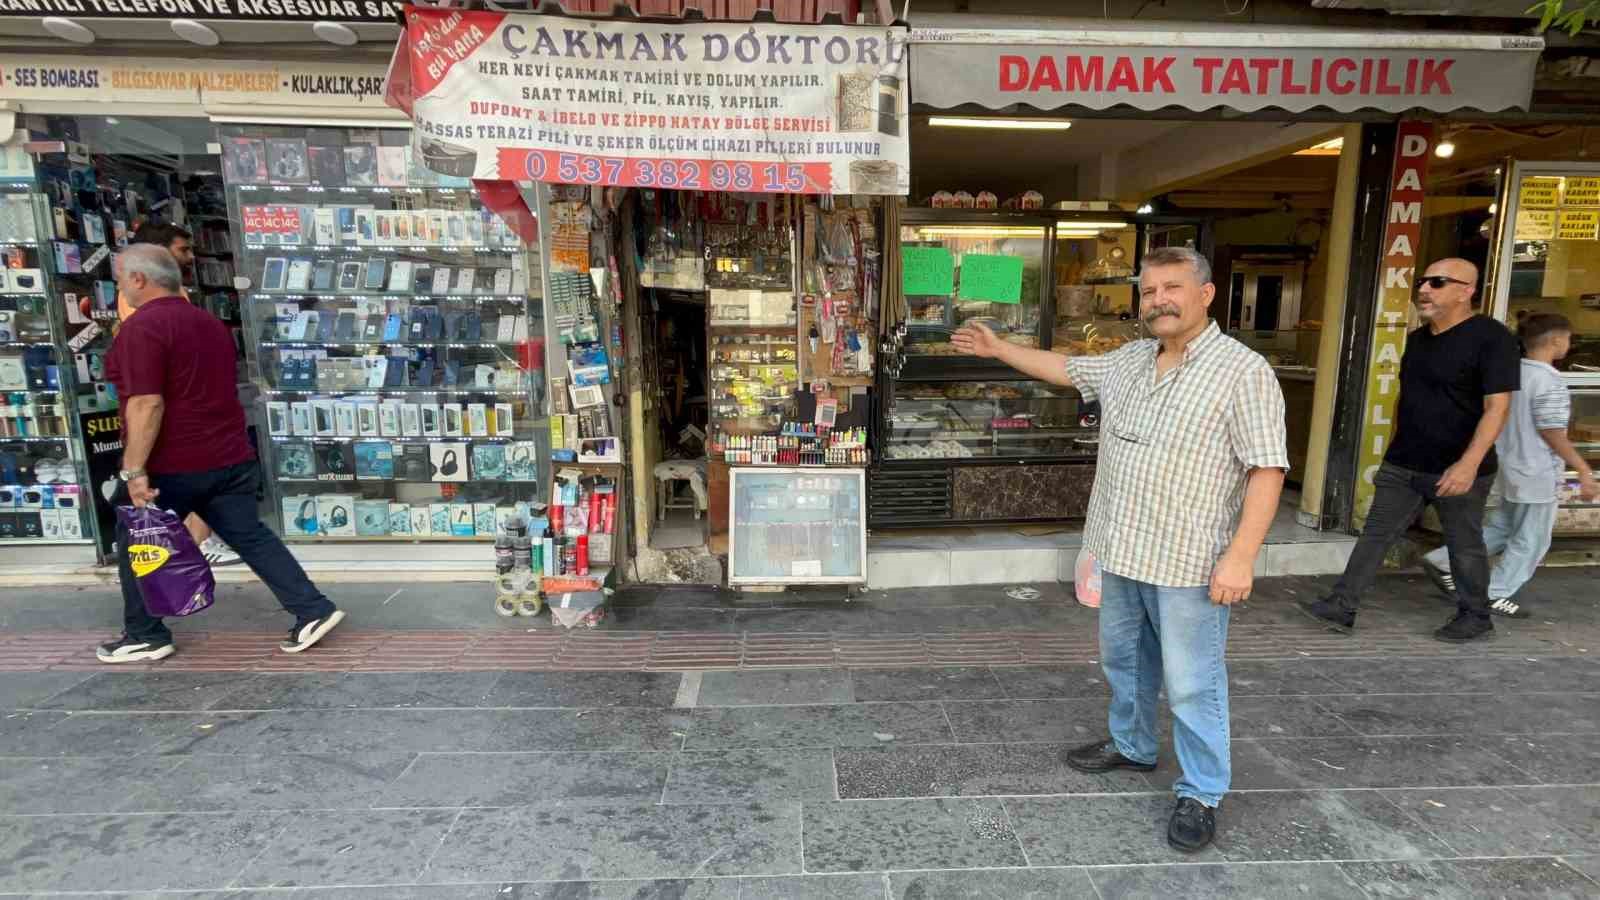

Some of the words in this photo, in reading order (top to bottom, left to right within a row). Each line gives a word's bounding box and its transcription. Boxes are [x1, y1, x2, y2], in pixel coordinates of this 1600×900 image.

[91, 0, 196, 14] TELEFON
[200, 0, 233, 15] VE
[237, 0, 361, 17] AKSESUAR
[502, 23, 688, 62] ÇAKMAK
[701, 32, 904, 65] DOKTORU
[15, 68, 37, 87] SES
[40, 68, 99, 88] BOMBASI
[478, 61, 508, 76] HER
[513, 62, 550, 77] NEVİ
[555, 66, 619, 82] ÇAKMAK
[623, 68, 679, 86] TAMİRİ
[684, 73, 702, 86] VE
[706, 73, 755, 87] DOLUM
[999, 54, 1177, 93] DAMAK
[1193, 57, 1457, 96] TATLICILIK
[521, 86, 562, 101] SAAT
[470, 101, 533, 120] DUPONT
[601, 113, 620, 126] VE
[624, 111, 667, 128] ZİPPO
[671, 116, 721, 131] HATAY
[725, 115, 769, 131] BÖLGE
[774, 115, 832, 133] SERVİSİ
[476, 124, 533, 141] TERAZİ
[538, 129, 569, 146] PİLİ
[574, 134, 593, 147] VE
[597, 135, 644, 153] ŞEKER
[648, 136, 698, 157] ÖLÇÜM
[702, 136, 750, 153] CİHAZI
[816, 142, 880, 155] BULUNUR
[525, 151, 547, 180] 0
[558, 152, 625, 184] 537
[634, 160, 701, 189] 382
[711, 161, 752, 190] 98
[762, 163, 806, 191] 15
